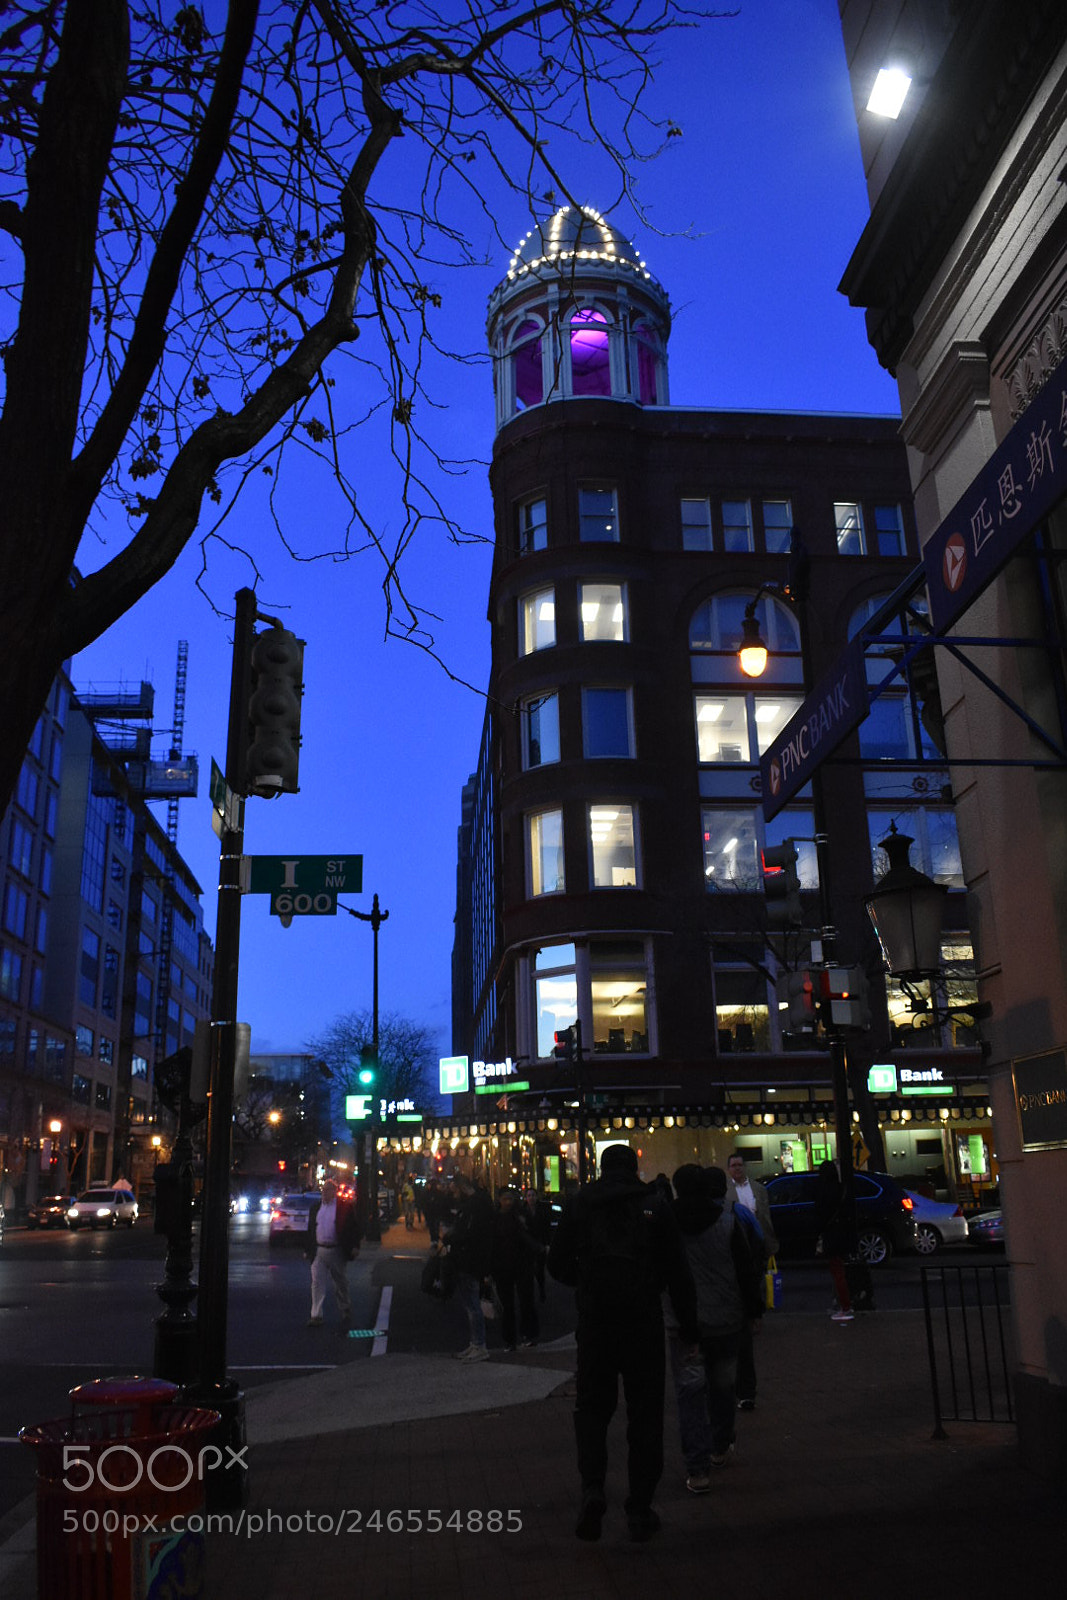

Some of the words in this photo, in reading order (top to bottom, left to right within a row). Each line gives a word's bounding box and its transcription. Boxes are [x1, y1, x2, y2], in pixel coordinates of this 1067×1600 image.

[280, 860, 300, 888] I
[326, 860, 346, 873] ST
[325, 875, 346, 888] NW
[275, 893, 331, 913] 600
[473, 1057, 518, 1078] Bank
[900, 1067, 944, 1083] Bank
